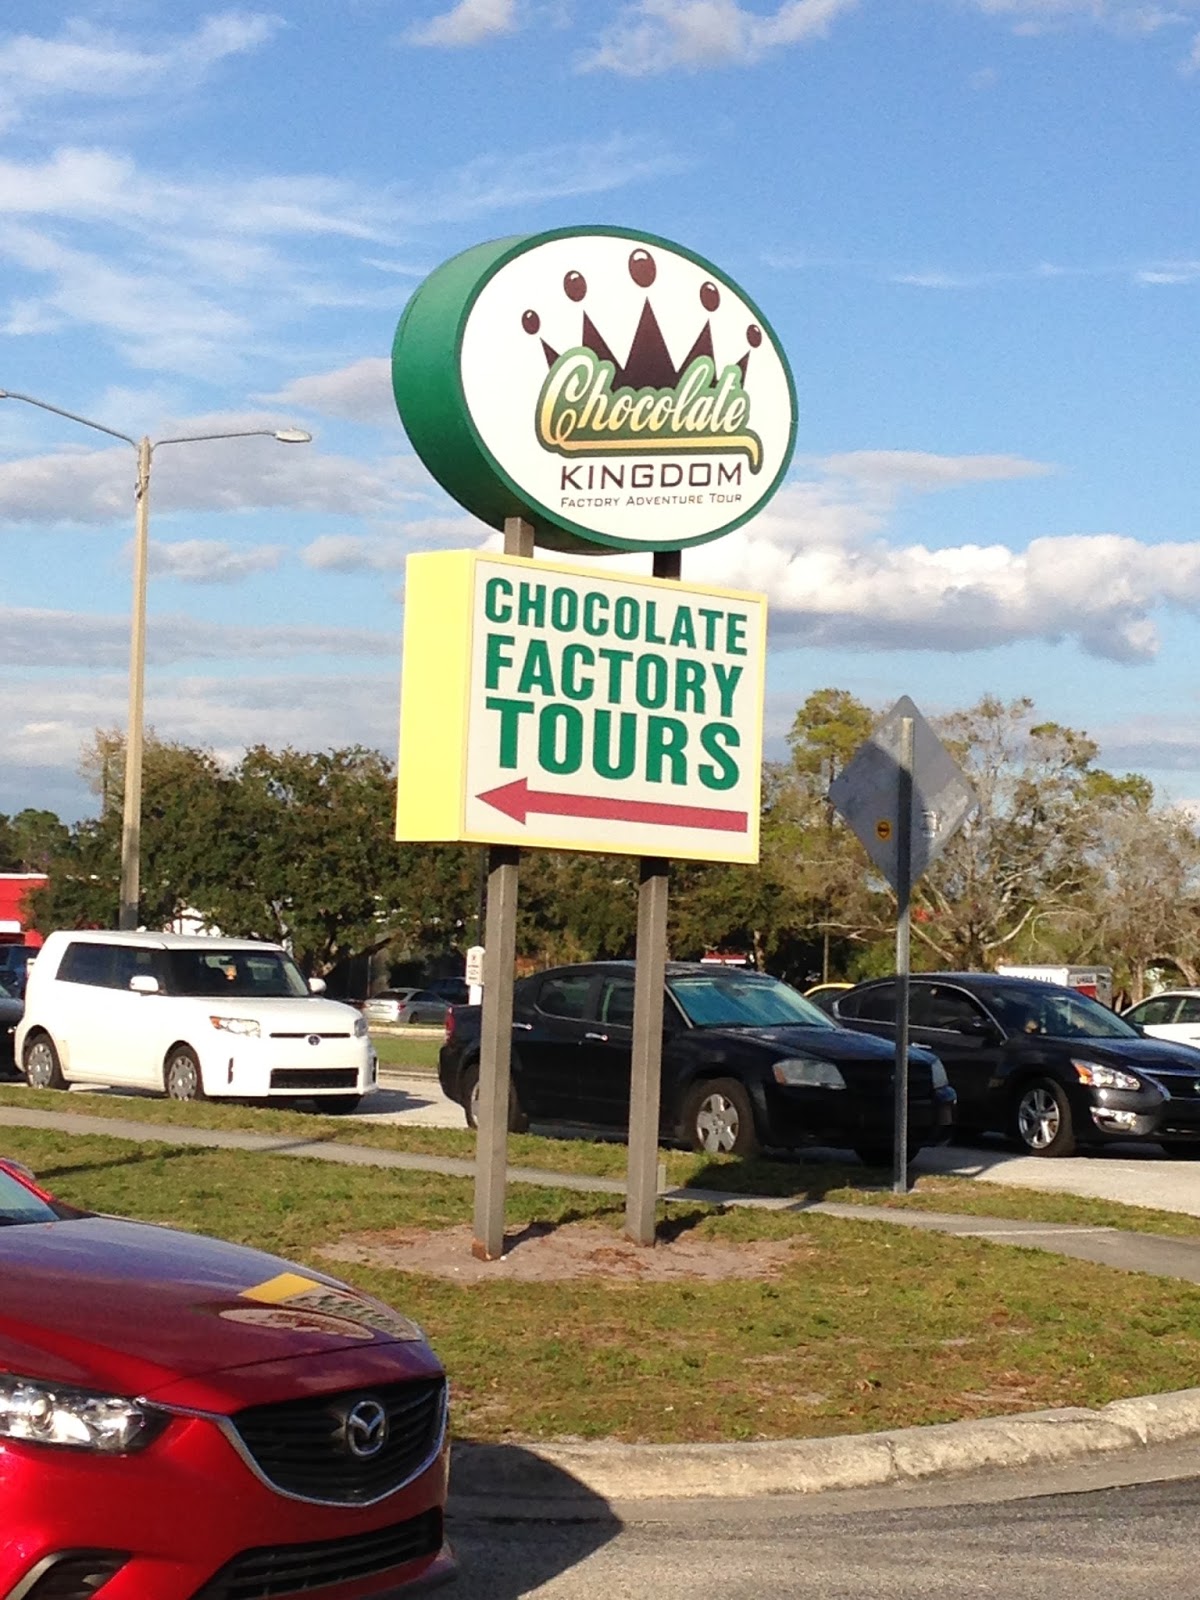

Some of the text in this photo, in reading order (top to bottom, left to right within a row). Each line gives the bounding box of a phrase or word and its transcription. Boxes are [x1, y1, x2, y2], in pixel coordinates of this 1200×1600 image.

[539, 353, 756, 449] Chocolate
[560, 462, 742, 490] KINGDOM
[485, 577, 747, 656] CHOCOLATE
[485, 633, 744, 718] FACTORY
[485, 696, 740, 791] TOURS
